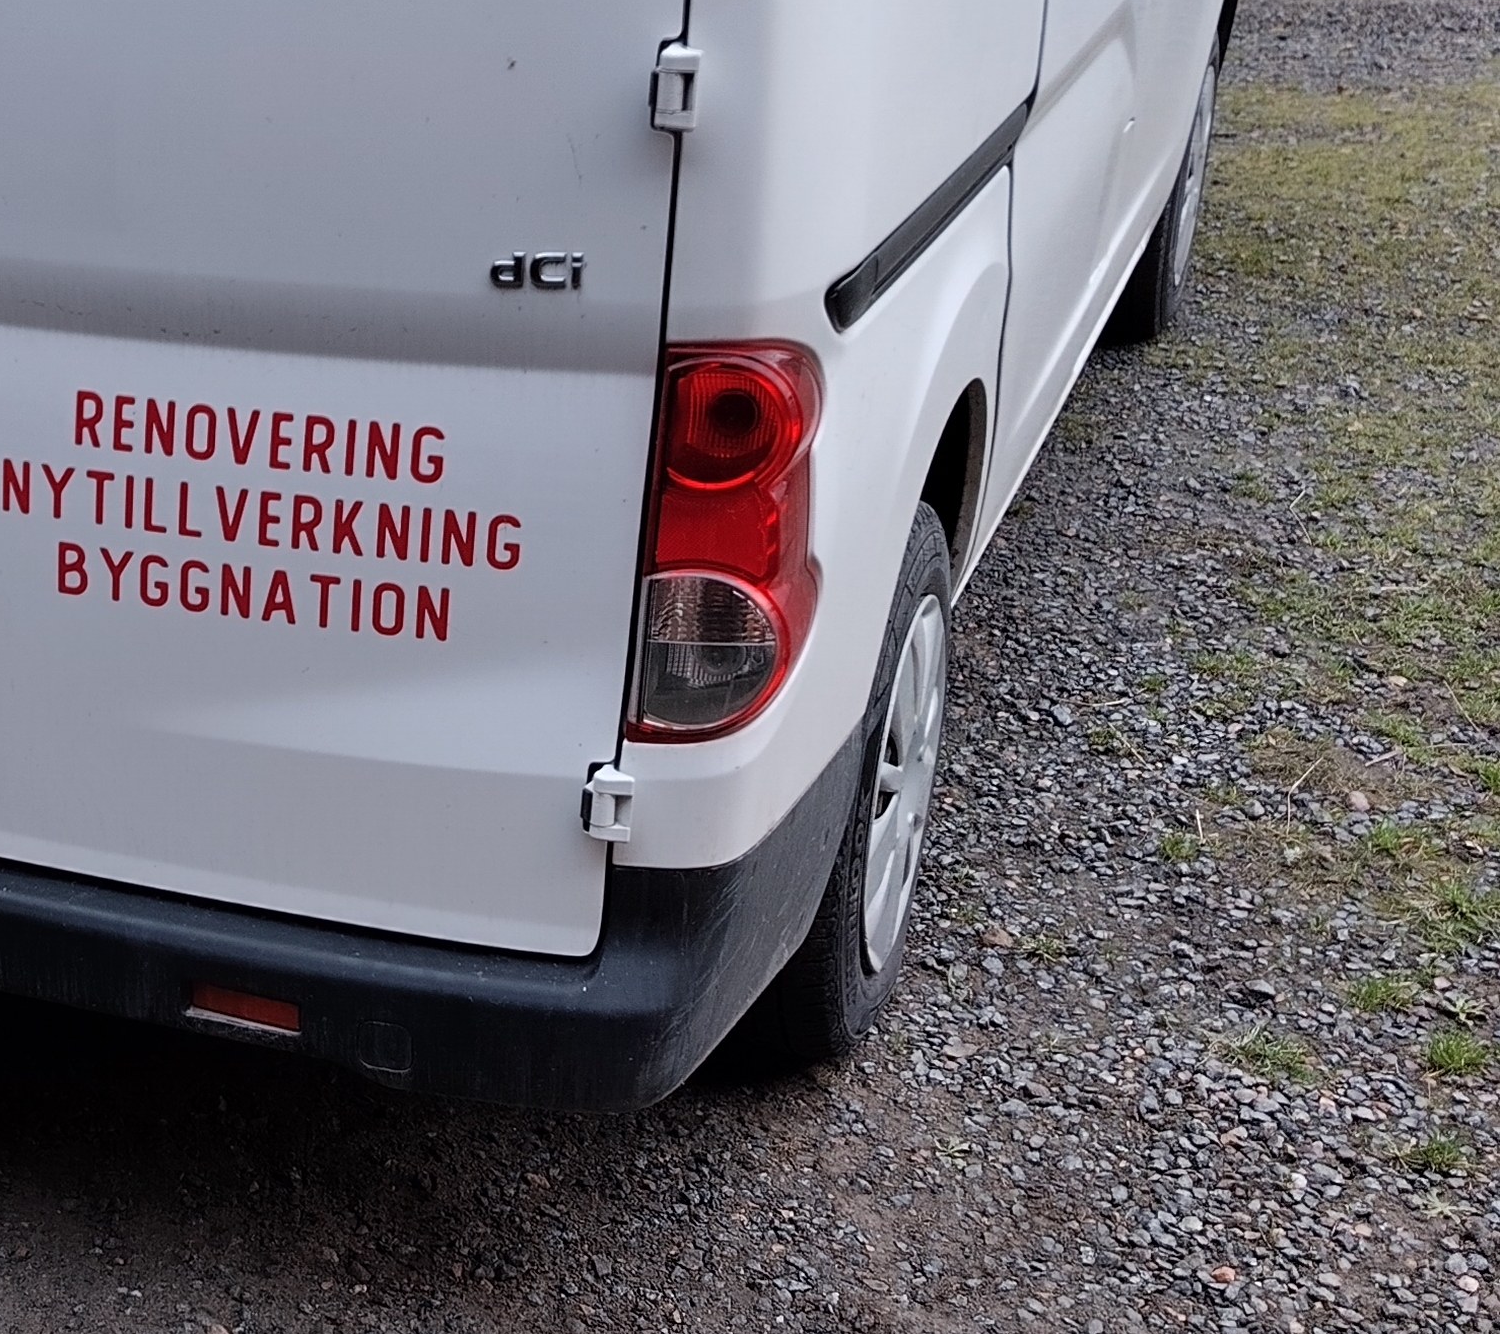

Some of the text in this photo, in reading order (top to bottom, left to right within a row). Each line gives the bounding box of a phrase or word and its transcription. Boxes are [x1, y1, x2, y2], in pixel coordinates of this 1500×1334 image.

[73, 390, 445, 485] RENOVERING
[2, 459, 522, 572] NYTILLVERKNING
[57, 540, 451, 642] BYGGNATION
